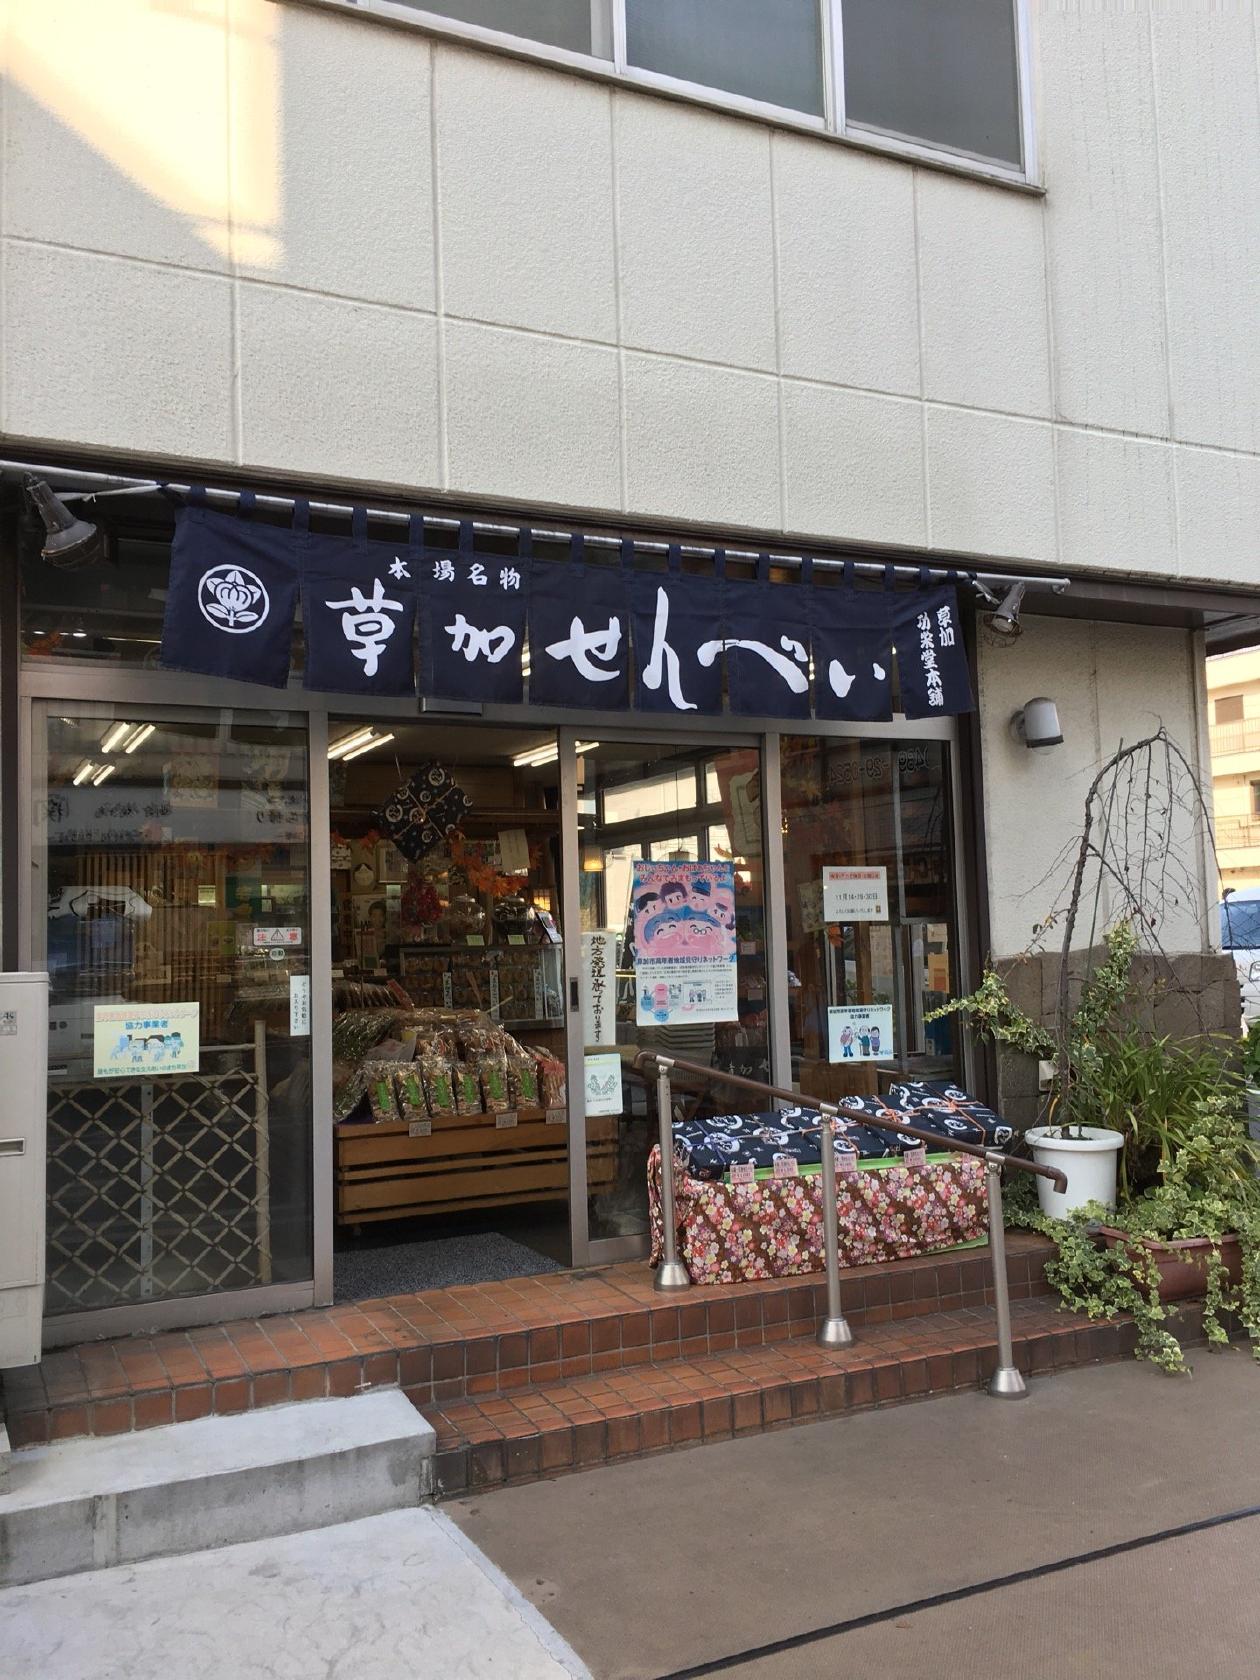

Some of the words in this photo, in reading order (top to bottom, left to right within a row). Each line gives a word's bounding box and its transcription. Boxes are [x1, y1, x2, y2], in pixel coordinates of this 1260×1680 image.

[388, 556, 521, 590] 本場名物
[325, 578, 886, 710] 草加せんべい
[936, 605, 955, 647] 草加
[125, 1020, 168, 1031] 協力事業者
